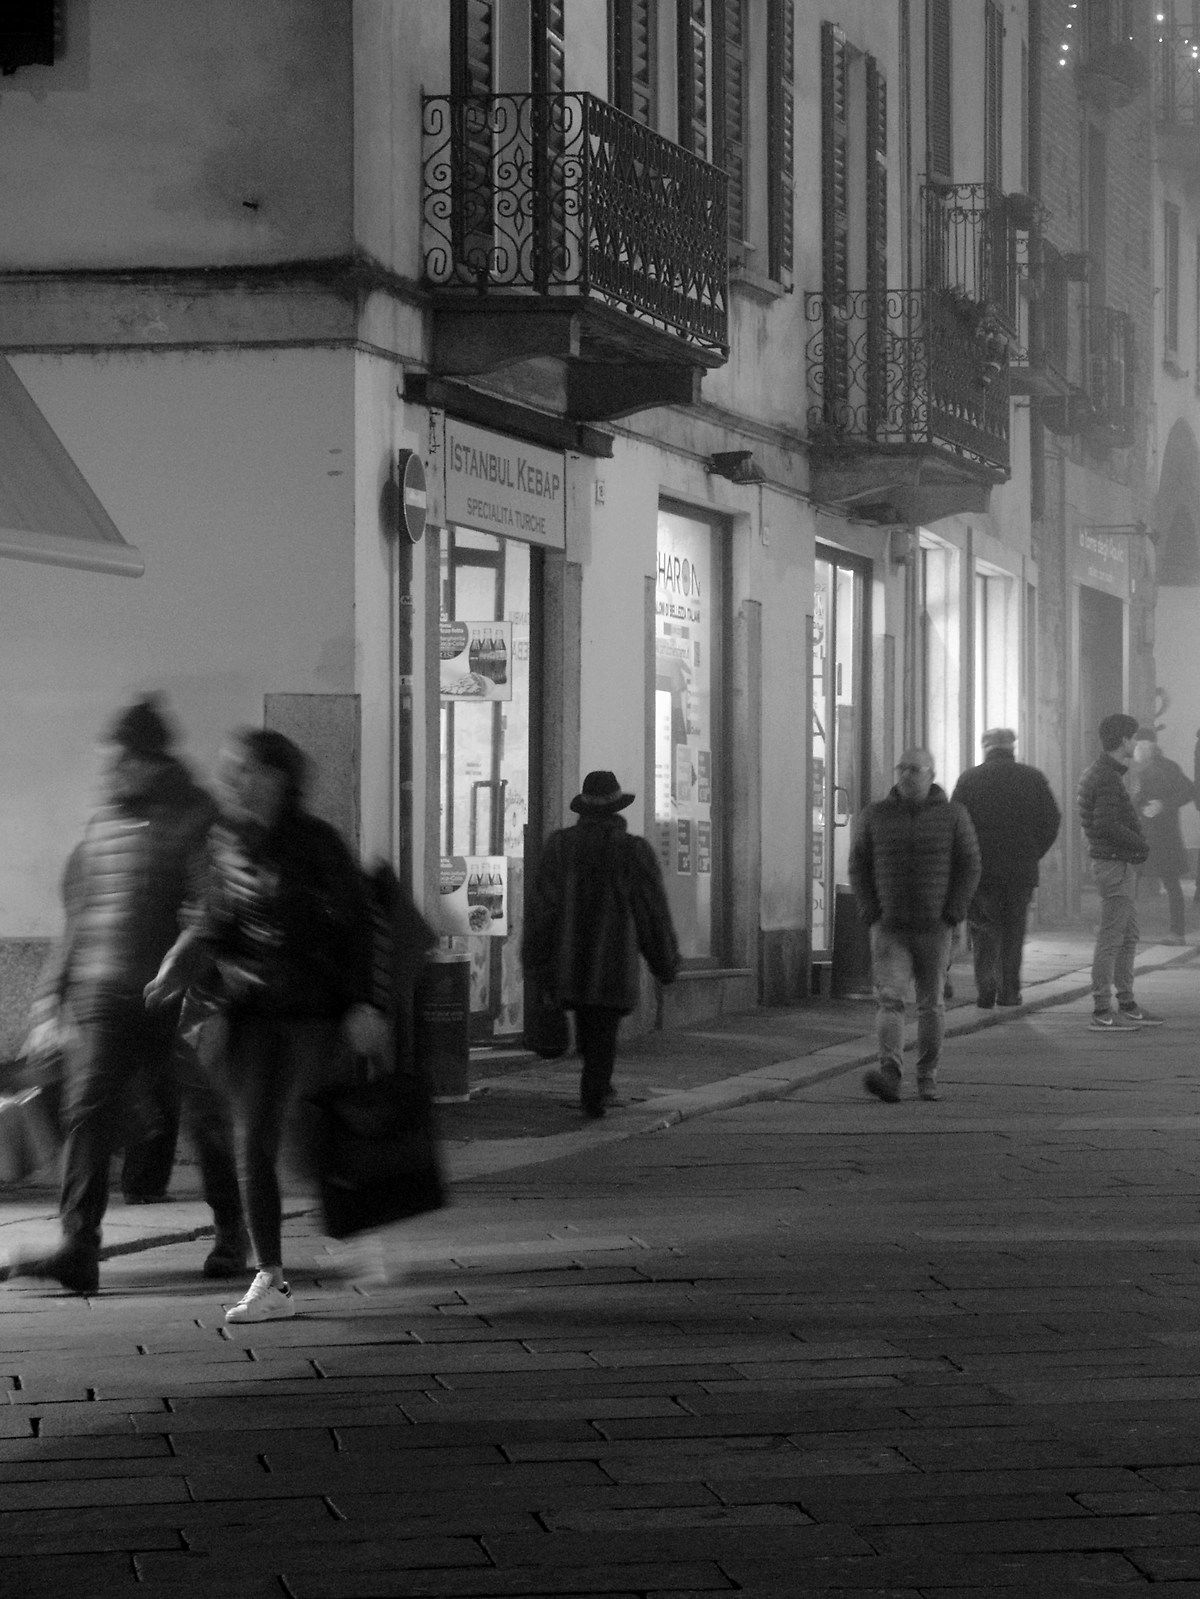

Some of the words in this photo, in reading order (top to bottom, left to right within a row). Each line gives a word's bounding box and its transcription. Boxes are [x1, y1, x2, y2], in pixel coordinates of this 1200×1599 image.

[449, 435, 514, 490] ISTANBUL
[516, 457, 561, 500] KEBAP
[515, 510, 547, 535] TURCHE
